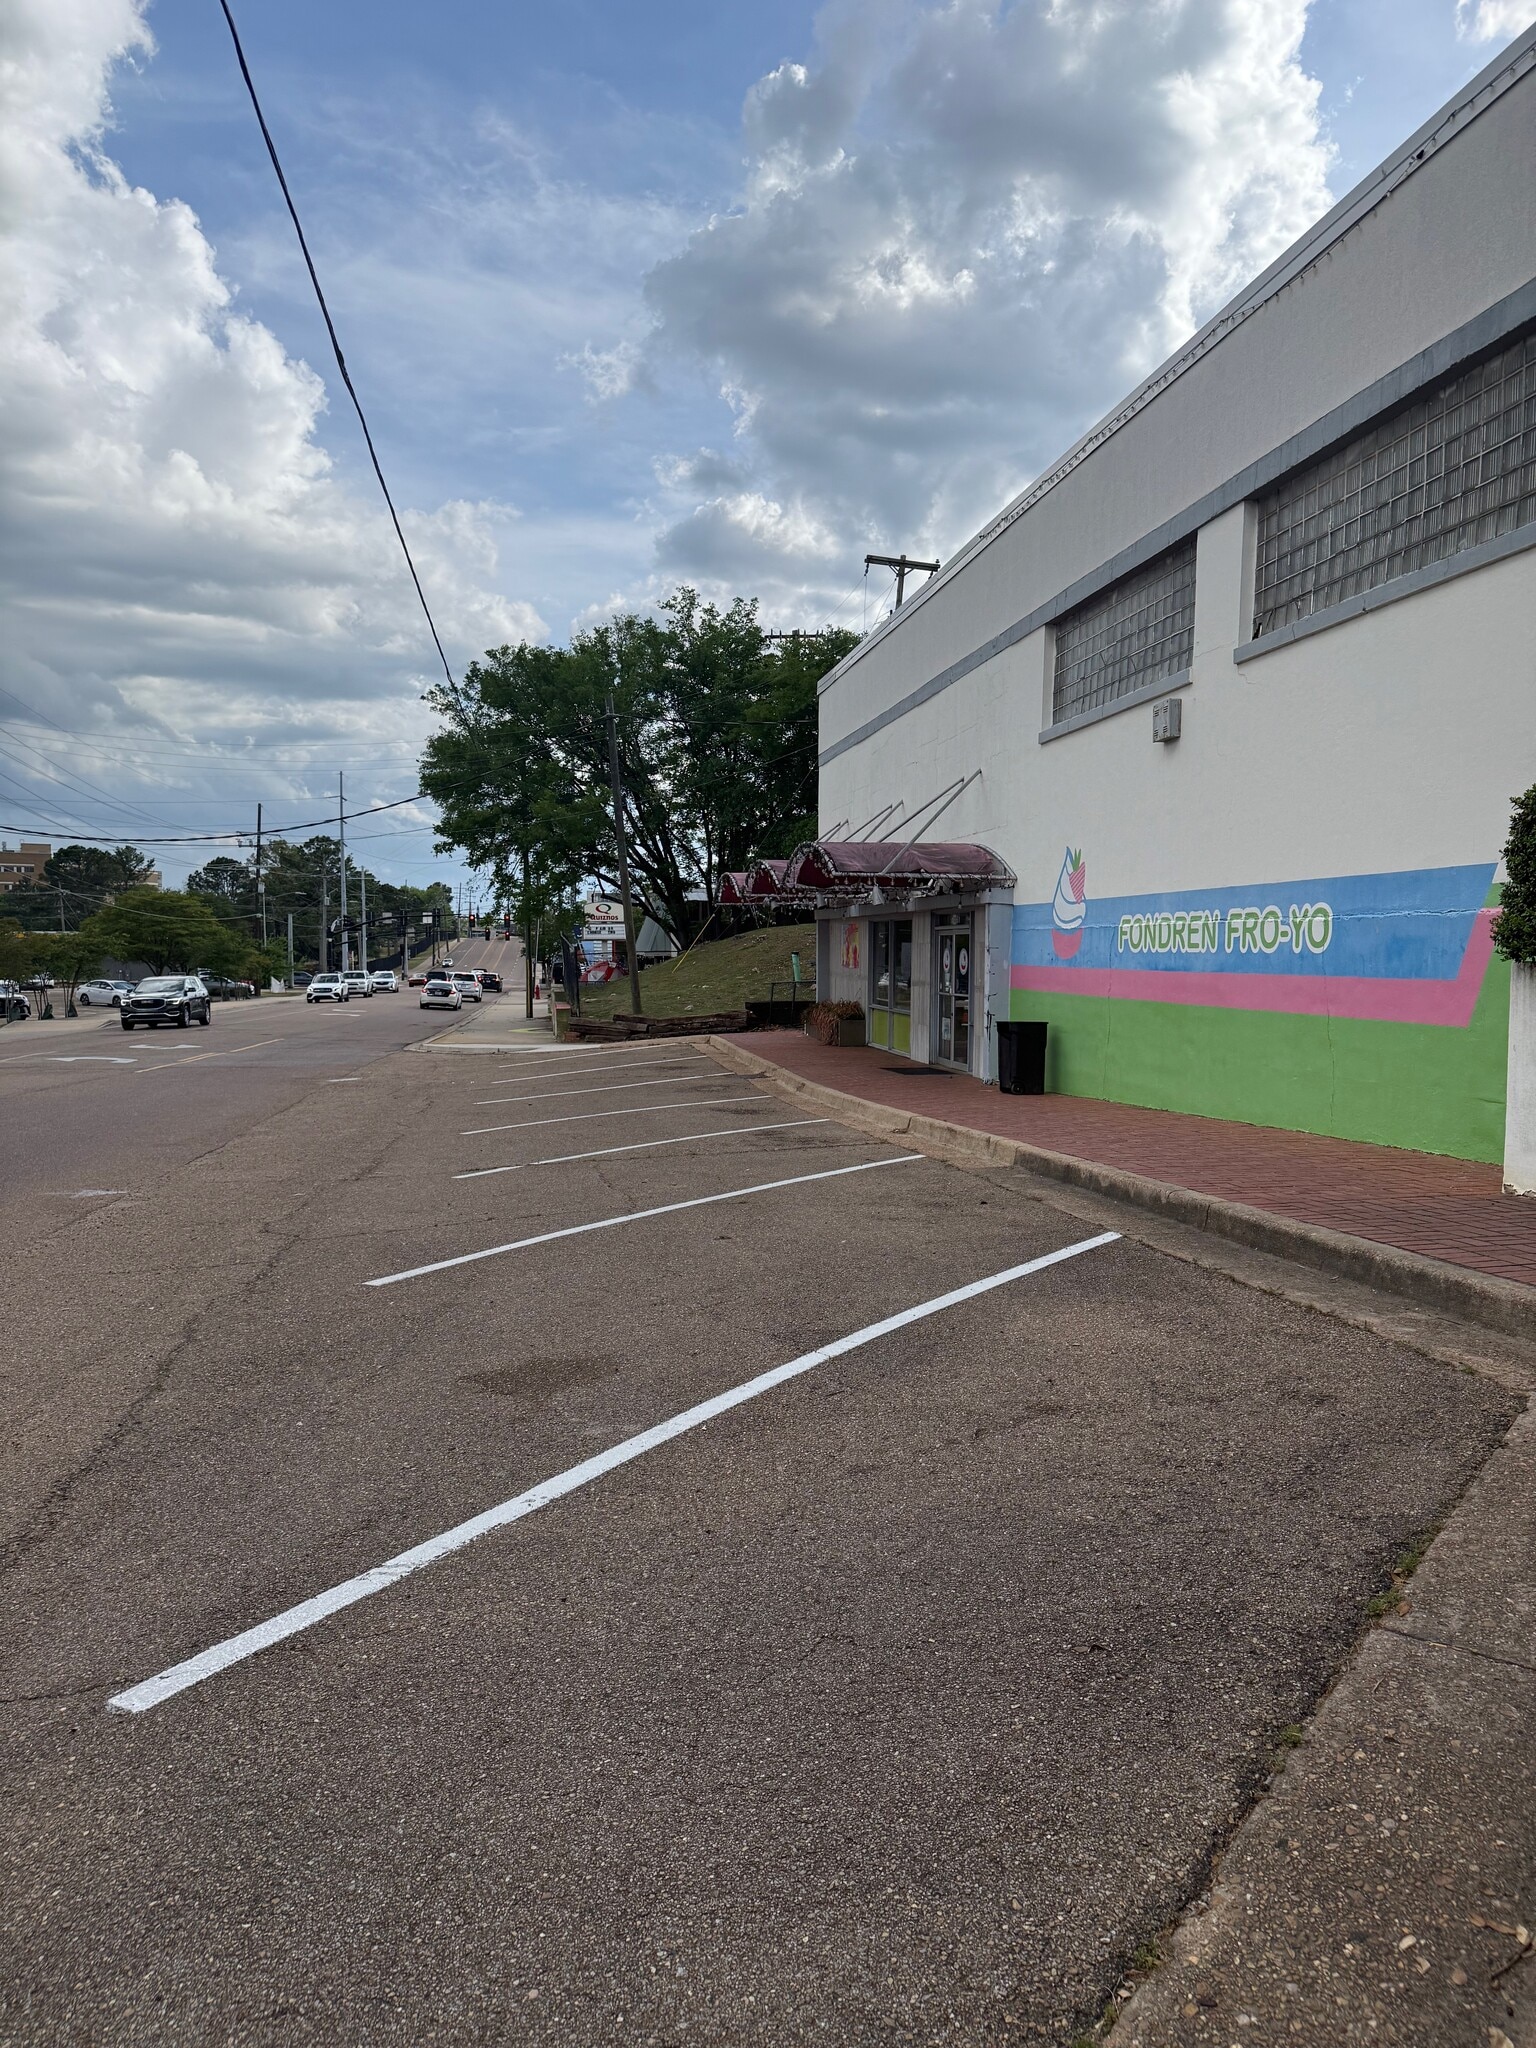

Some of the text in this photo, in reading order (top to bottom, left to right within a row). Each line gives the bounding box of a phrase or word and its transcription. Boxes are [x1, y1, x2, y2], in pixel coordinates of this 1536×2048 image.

[595, 903, 611, 914] Q
[1117, 901, 1333, 954] FONDREN FRO-YO
